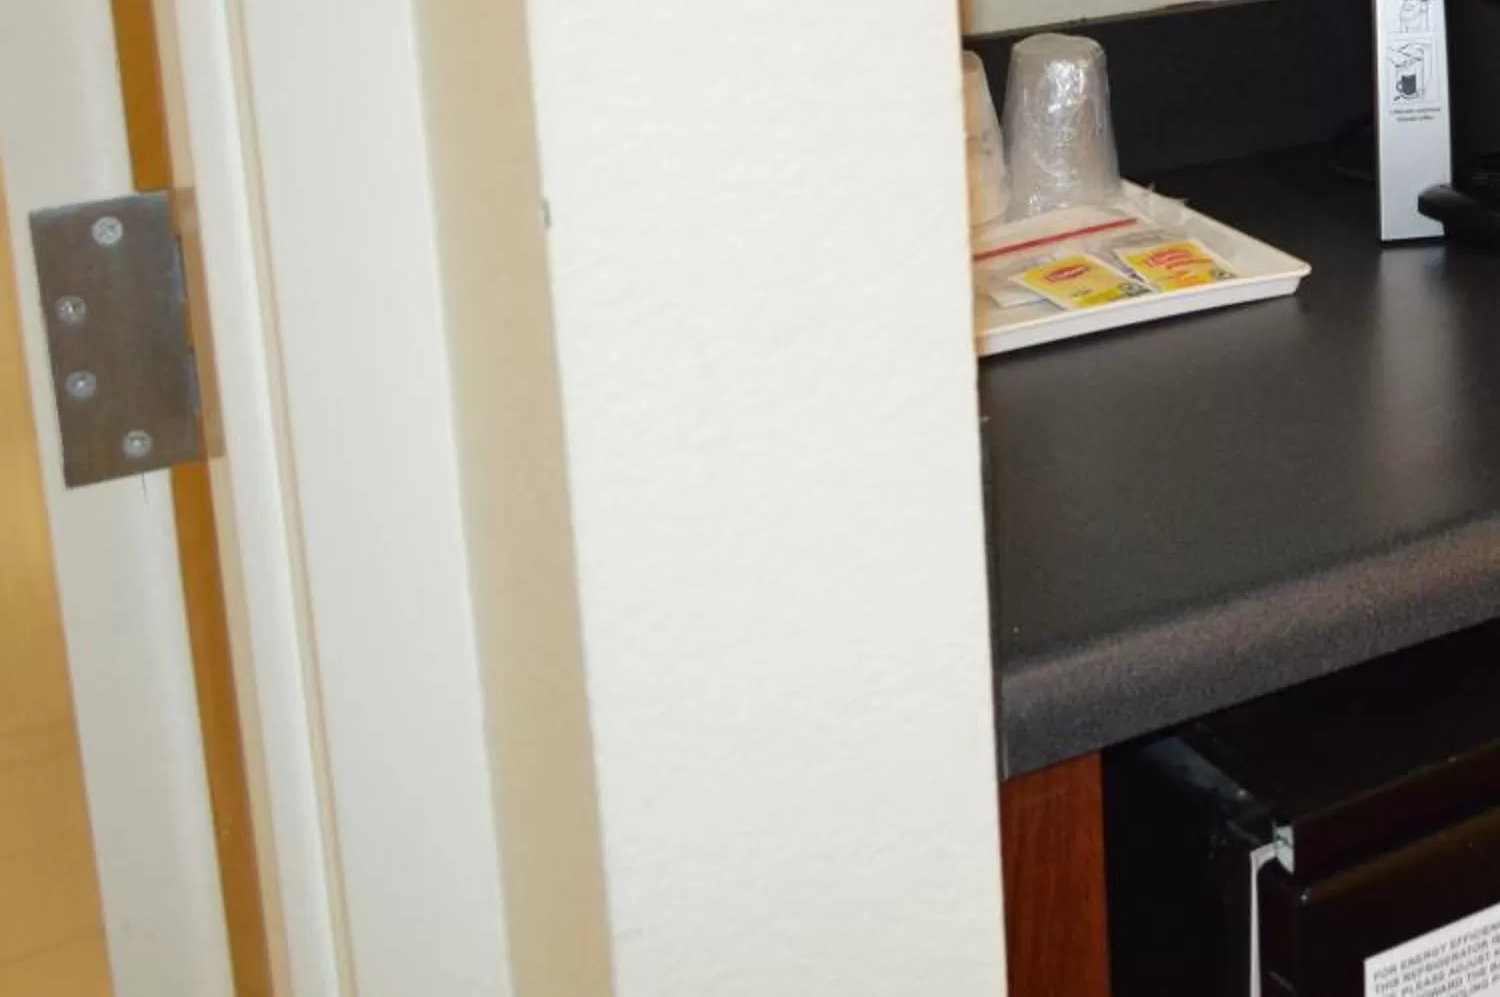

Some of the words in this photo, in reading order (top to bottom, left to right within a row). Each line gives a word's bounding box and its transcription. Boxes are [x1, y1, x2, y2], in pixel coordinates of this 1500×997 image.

[1373, 963, 1397, 982] FOR
[1400, 941, 1447, 971] ENERGY
[1402, 939, 1489, 982] REFRIGERATOR
[1447, 950, 1489, 977] ADJUST
